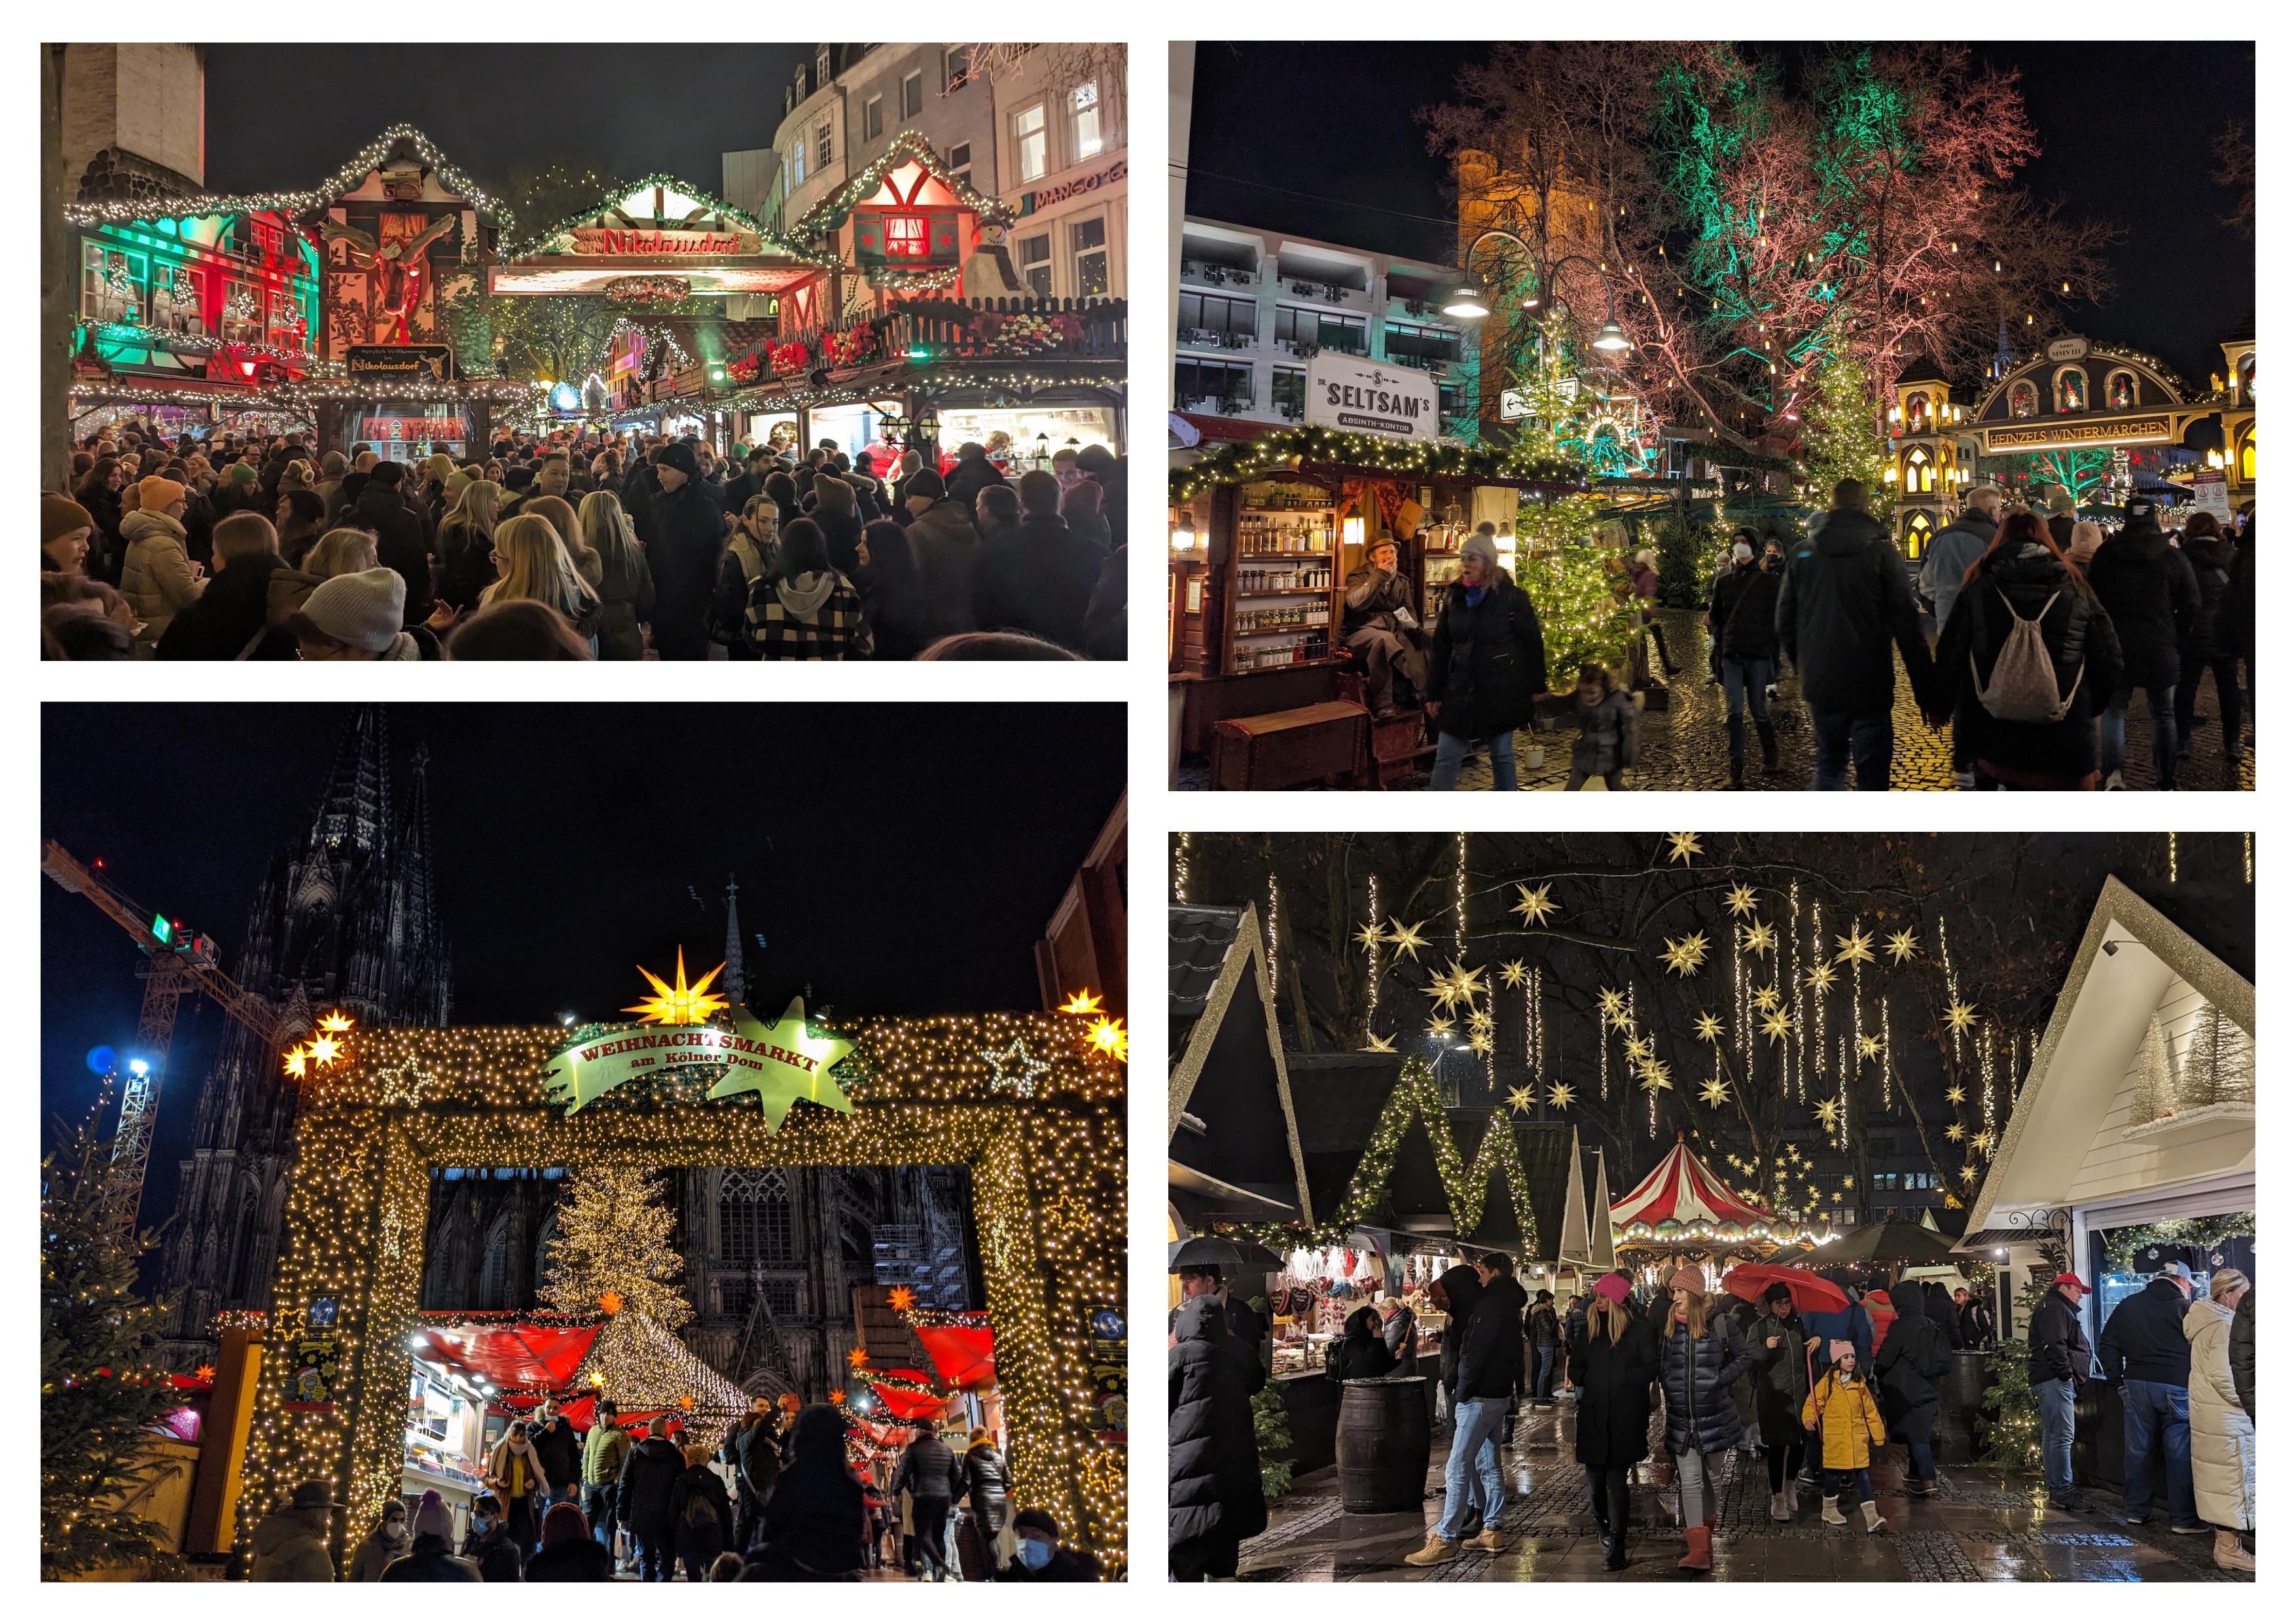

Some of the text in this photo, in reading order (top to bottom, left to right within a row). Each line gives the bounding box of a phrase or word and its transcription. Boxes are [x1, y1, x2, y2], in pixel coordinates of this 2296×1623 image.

[1035, 173, 1100, 211] MANGO
[603, 229, 742, 255] Nikolausdorf
[2052, 349, 2081, 357] MMVIII
[351, 359, 420, 372] Nikolausdorf
[1342, 417, 1409, 432] ABSINTH-KONTOR
[1990, 421, 2169, 445] HEINZELS WINTERMÄRCHEN
[580, 1033, 819, 1072] WEIHNACHTSMARKT
[630, 1052, 764, 1071] am Kölner Dom
